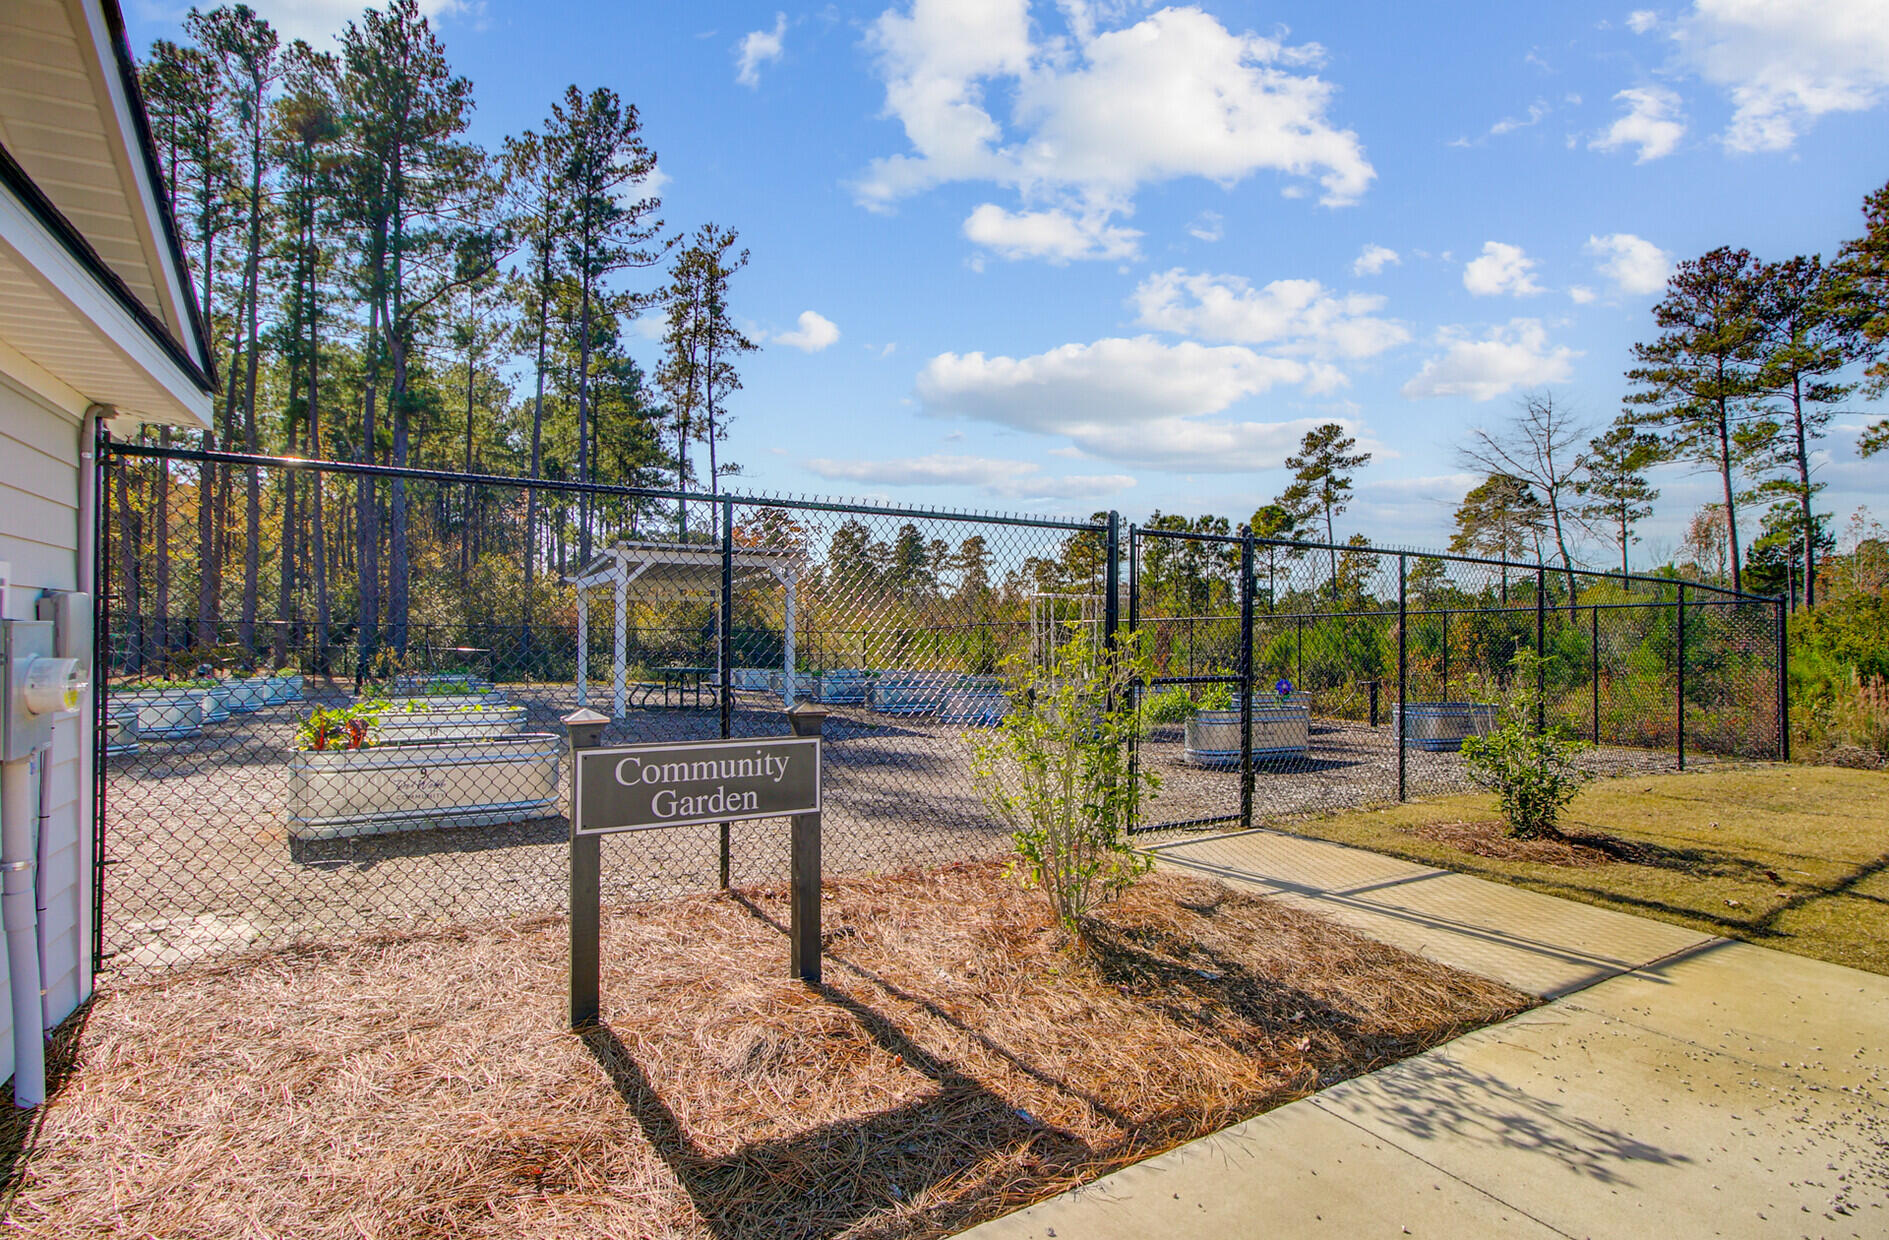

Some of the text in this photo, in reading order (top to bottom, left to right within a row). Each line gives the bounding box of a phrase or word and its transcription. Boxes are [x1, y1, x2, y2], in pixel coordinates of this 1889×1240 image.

[420, 768, 427, 779] 9
[614, 750, 790, 786] Community
[651, 786, 759, 818] Garden
